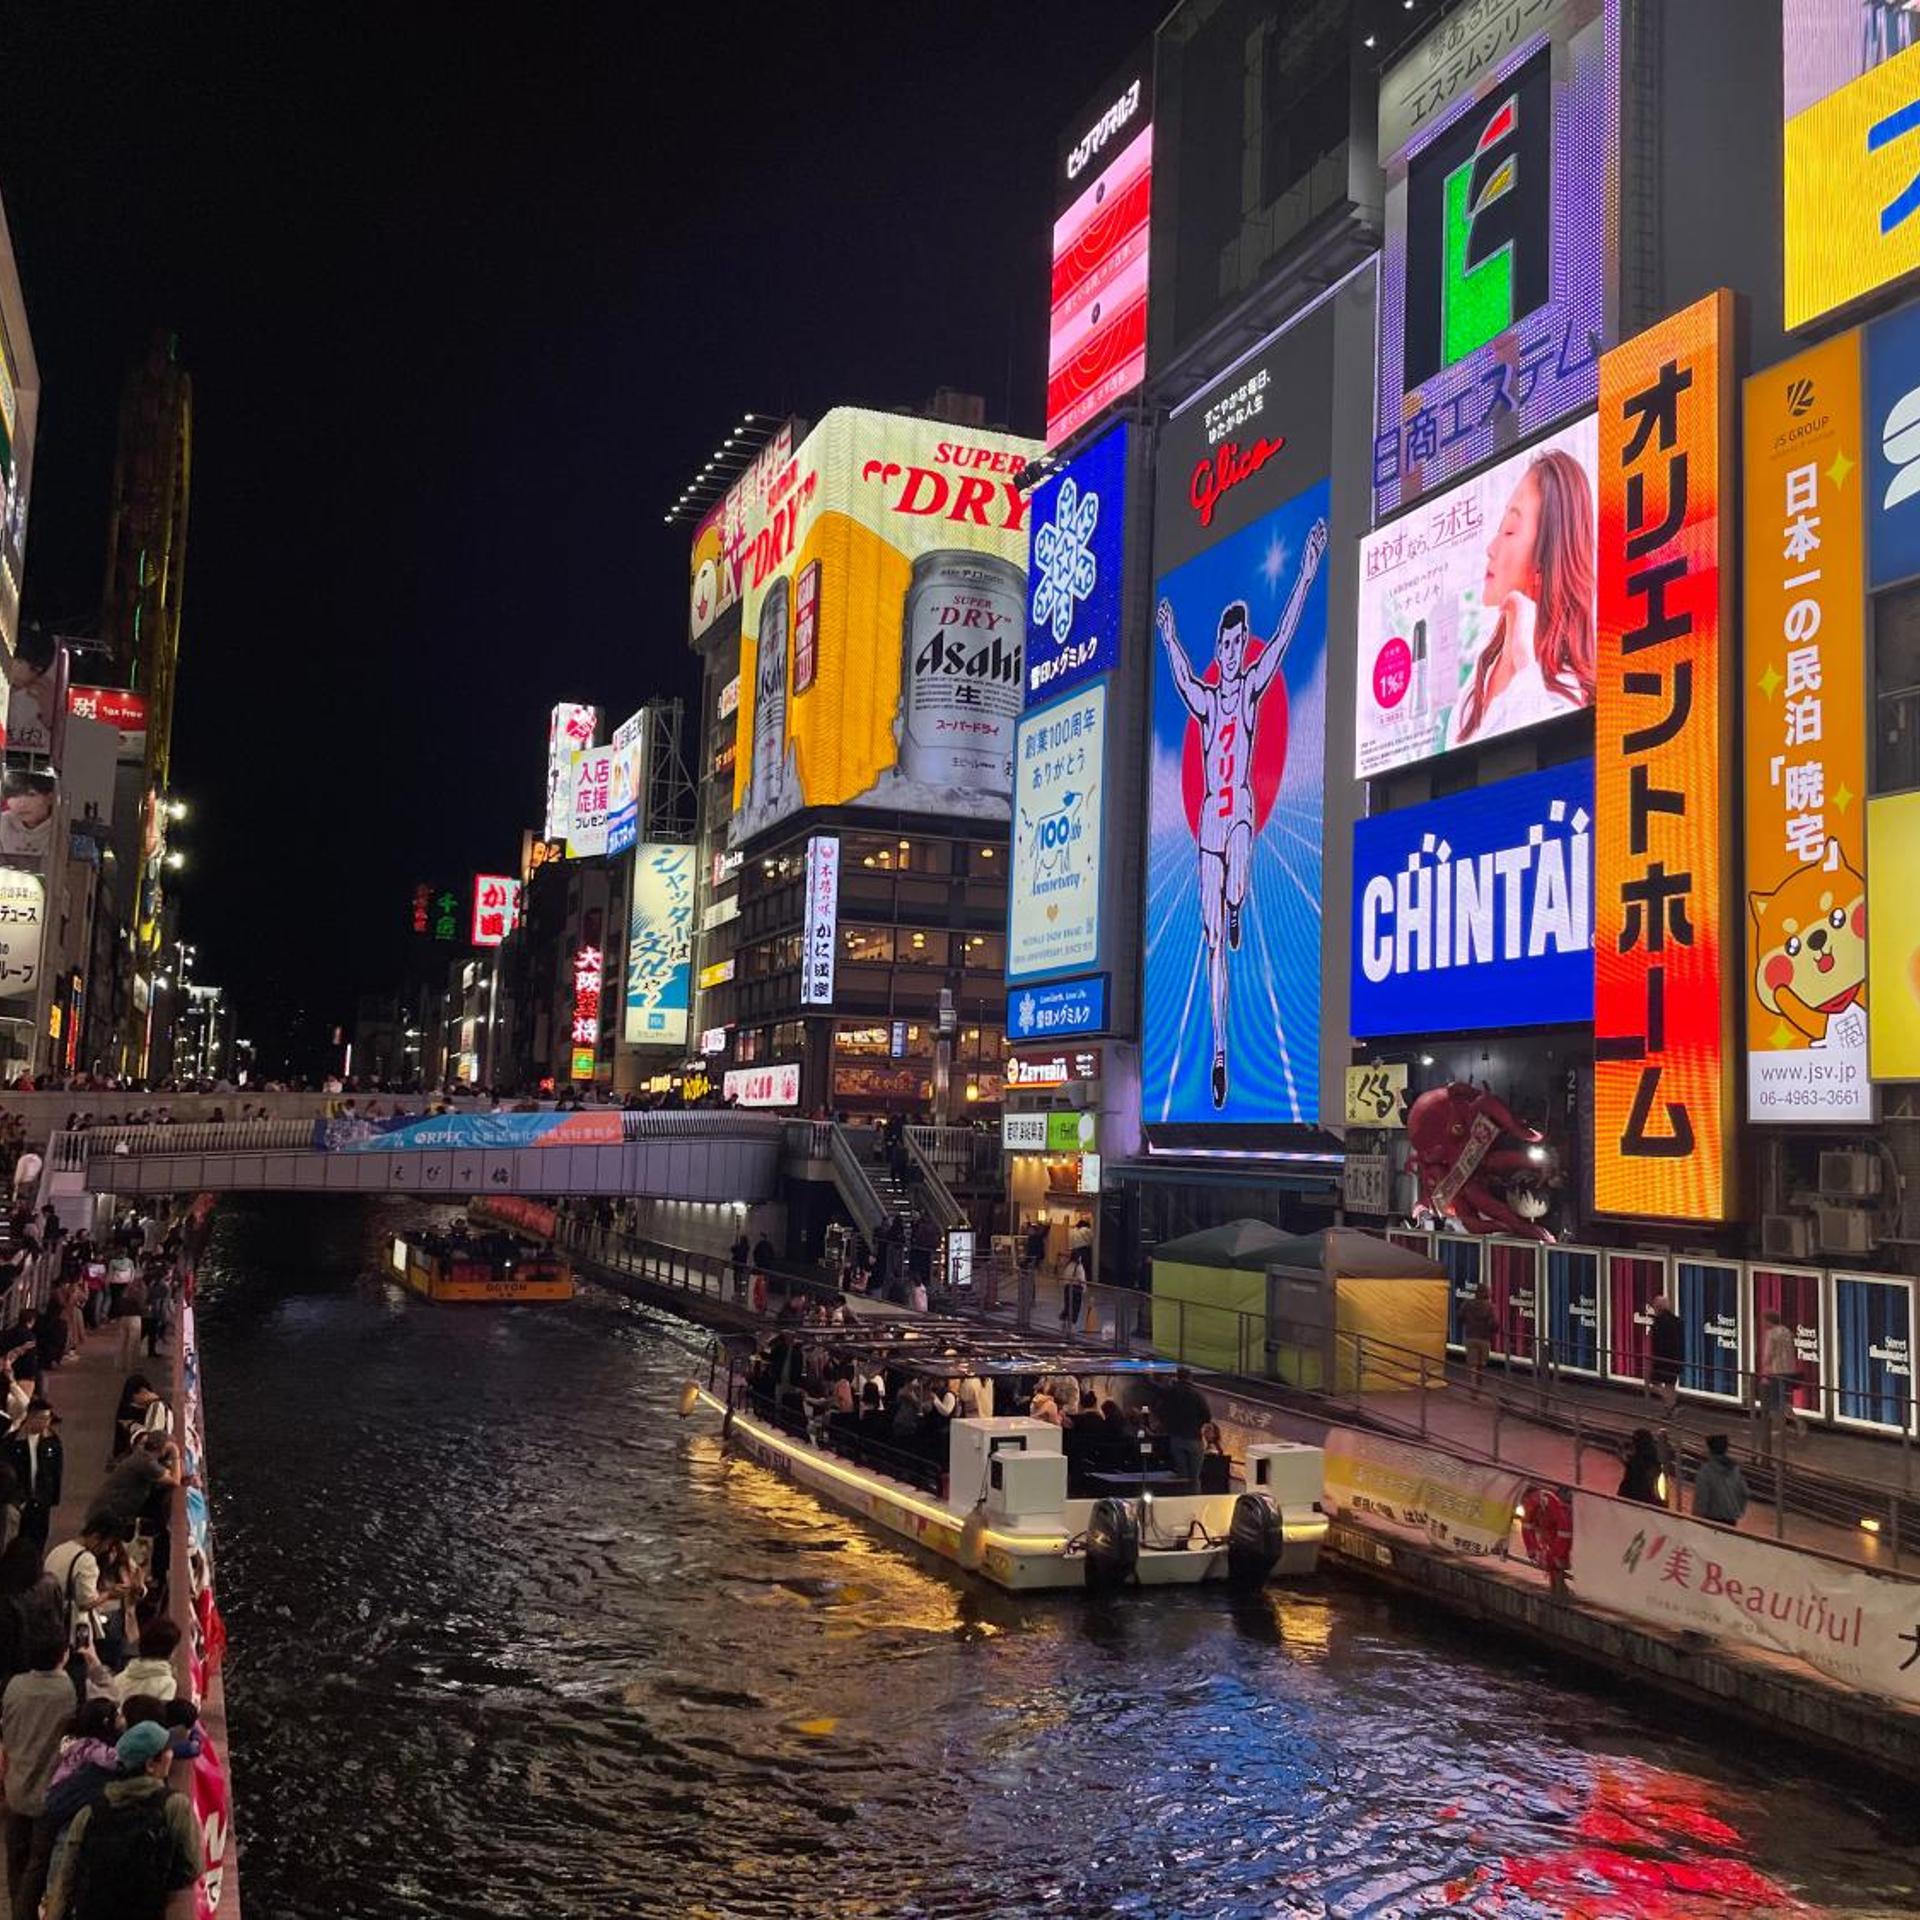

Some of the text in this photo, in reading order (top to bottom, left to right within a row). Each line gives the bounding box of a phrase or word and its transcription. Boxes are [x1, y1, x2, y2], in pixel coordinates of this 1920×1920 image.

[1374, 319, 1600, 488] 日商エステム
[1789, 415, 1830, 441] GROUP
[934, 442, 1028, 475] SUPER
[1190, 437, 1285, 528] Glico
[954, 594, 992, 609] SUPER
[915, 629, 1022, 687] Asahi
[1030, 636, 1098, 690] 雪印メグミルク
[954, 684, 982, 706] 生
[936, 719, 1000, 736] スーパードライ
[1025, 707, 1096, 760] 創業100周年
[577, 758, 610, 786] 入店
[1032, 748, 1085, 789] ありがとう
[1218, 715, 1237, 818] グリコ
[1619, 358, 1696, 1158] オリエントホーム
[1040, 815, 1071, 850] 100
[1363, 800, 1590, 982] CHINTAI
[814, 922, 832, 998] かに道楽
[1761, 1061, 1857, 1083] www.jsv.jp
[1357, 1073, 1394, 1118] くくる
[1760, 1090, 1860, 1106] 06-4963-3661
[1660, 1545, 1693, 1589] 美
[1700, 1561, 1863, 1647] Beautiful
